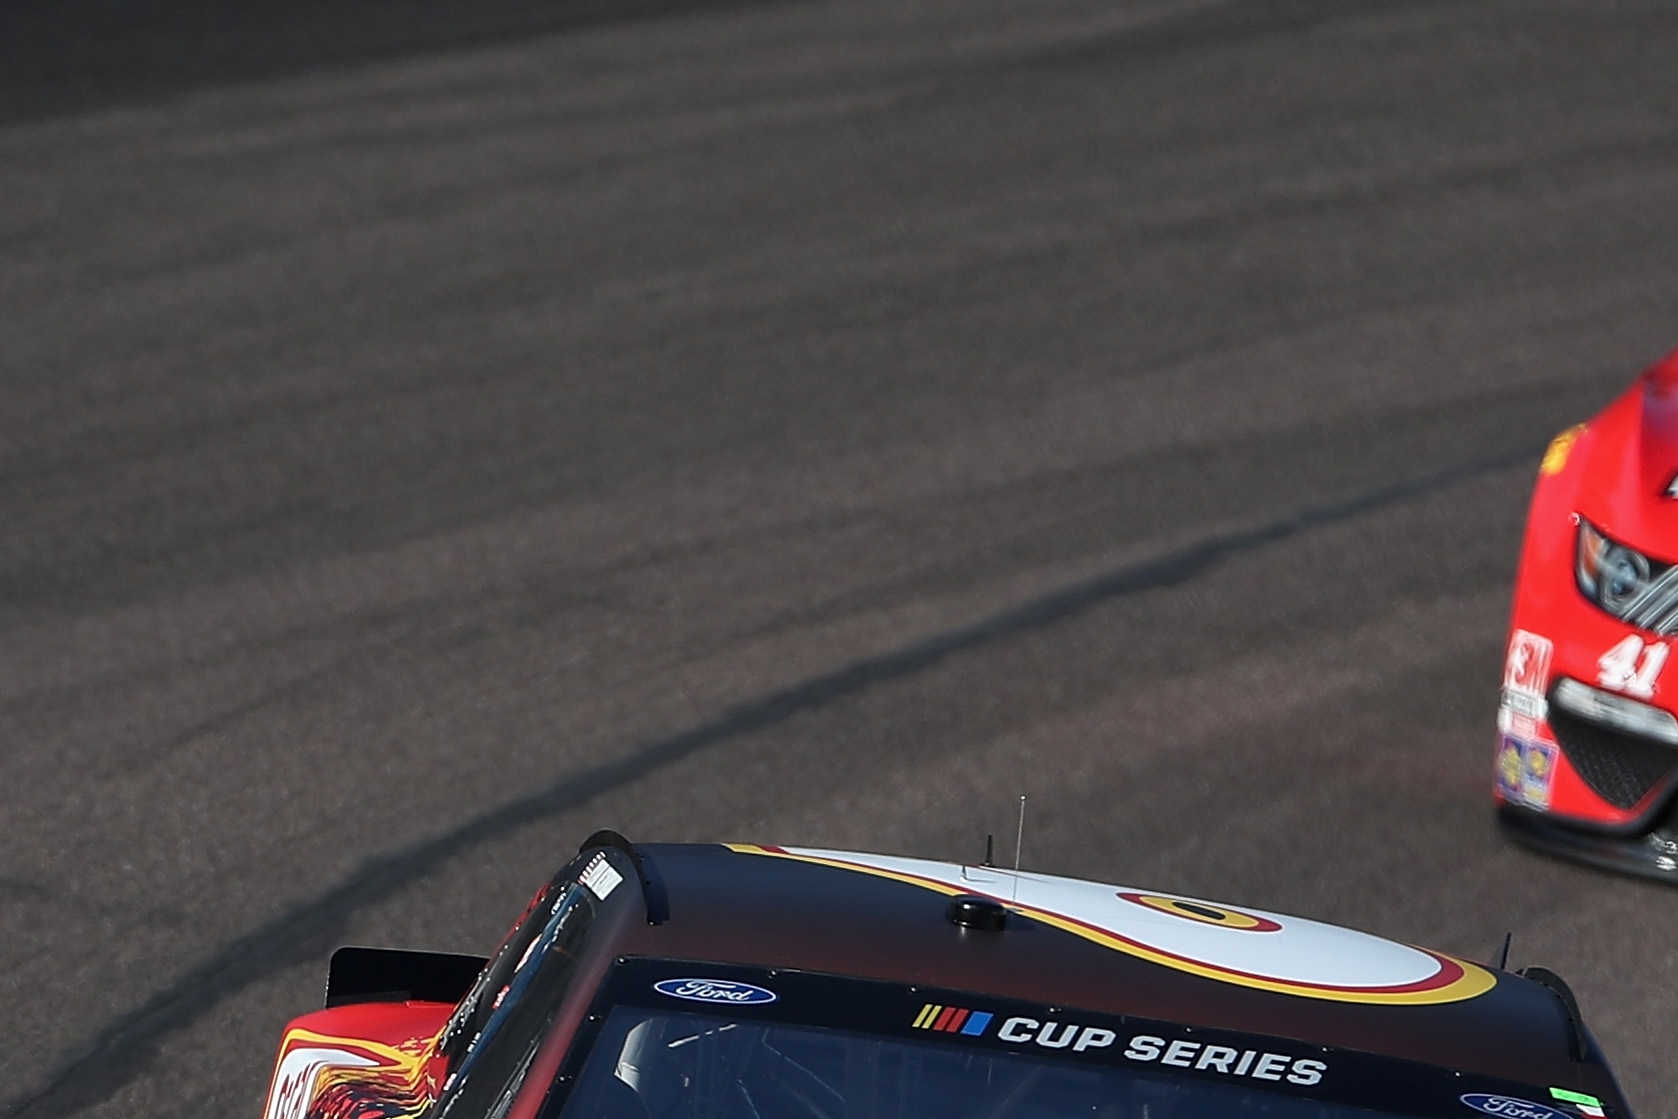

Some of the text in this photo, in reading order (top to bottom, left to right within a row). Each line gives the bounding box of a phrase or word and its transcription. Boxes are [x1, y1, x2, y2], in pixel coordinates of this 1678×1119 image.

[1599, 634, 1671, 698] 41
[674, 980, 756, 1002] Ford
[998, 1016, 1327, 1087] CUP SERIES
